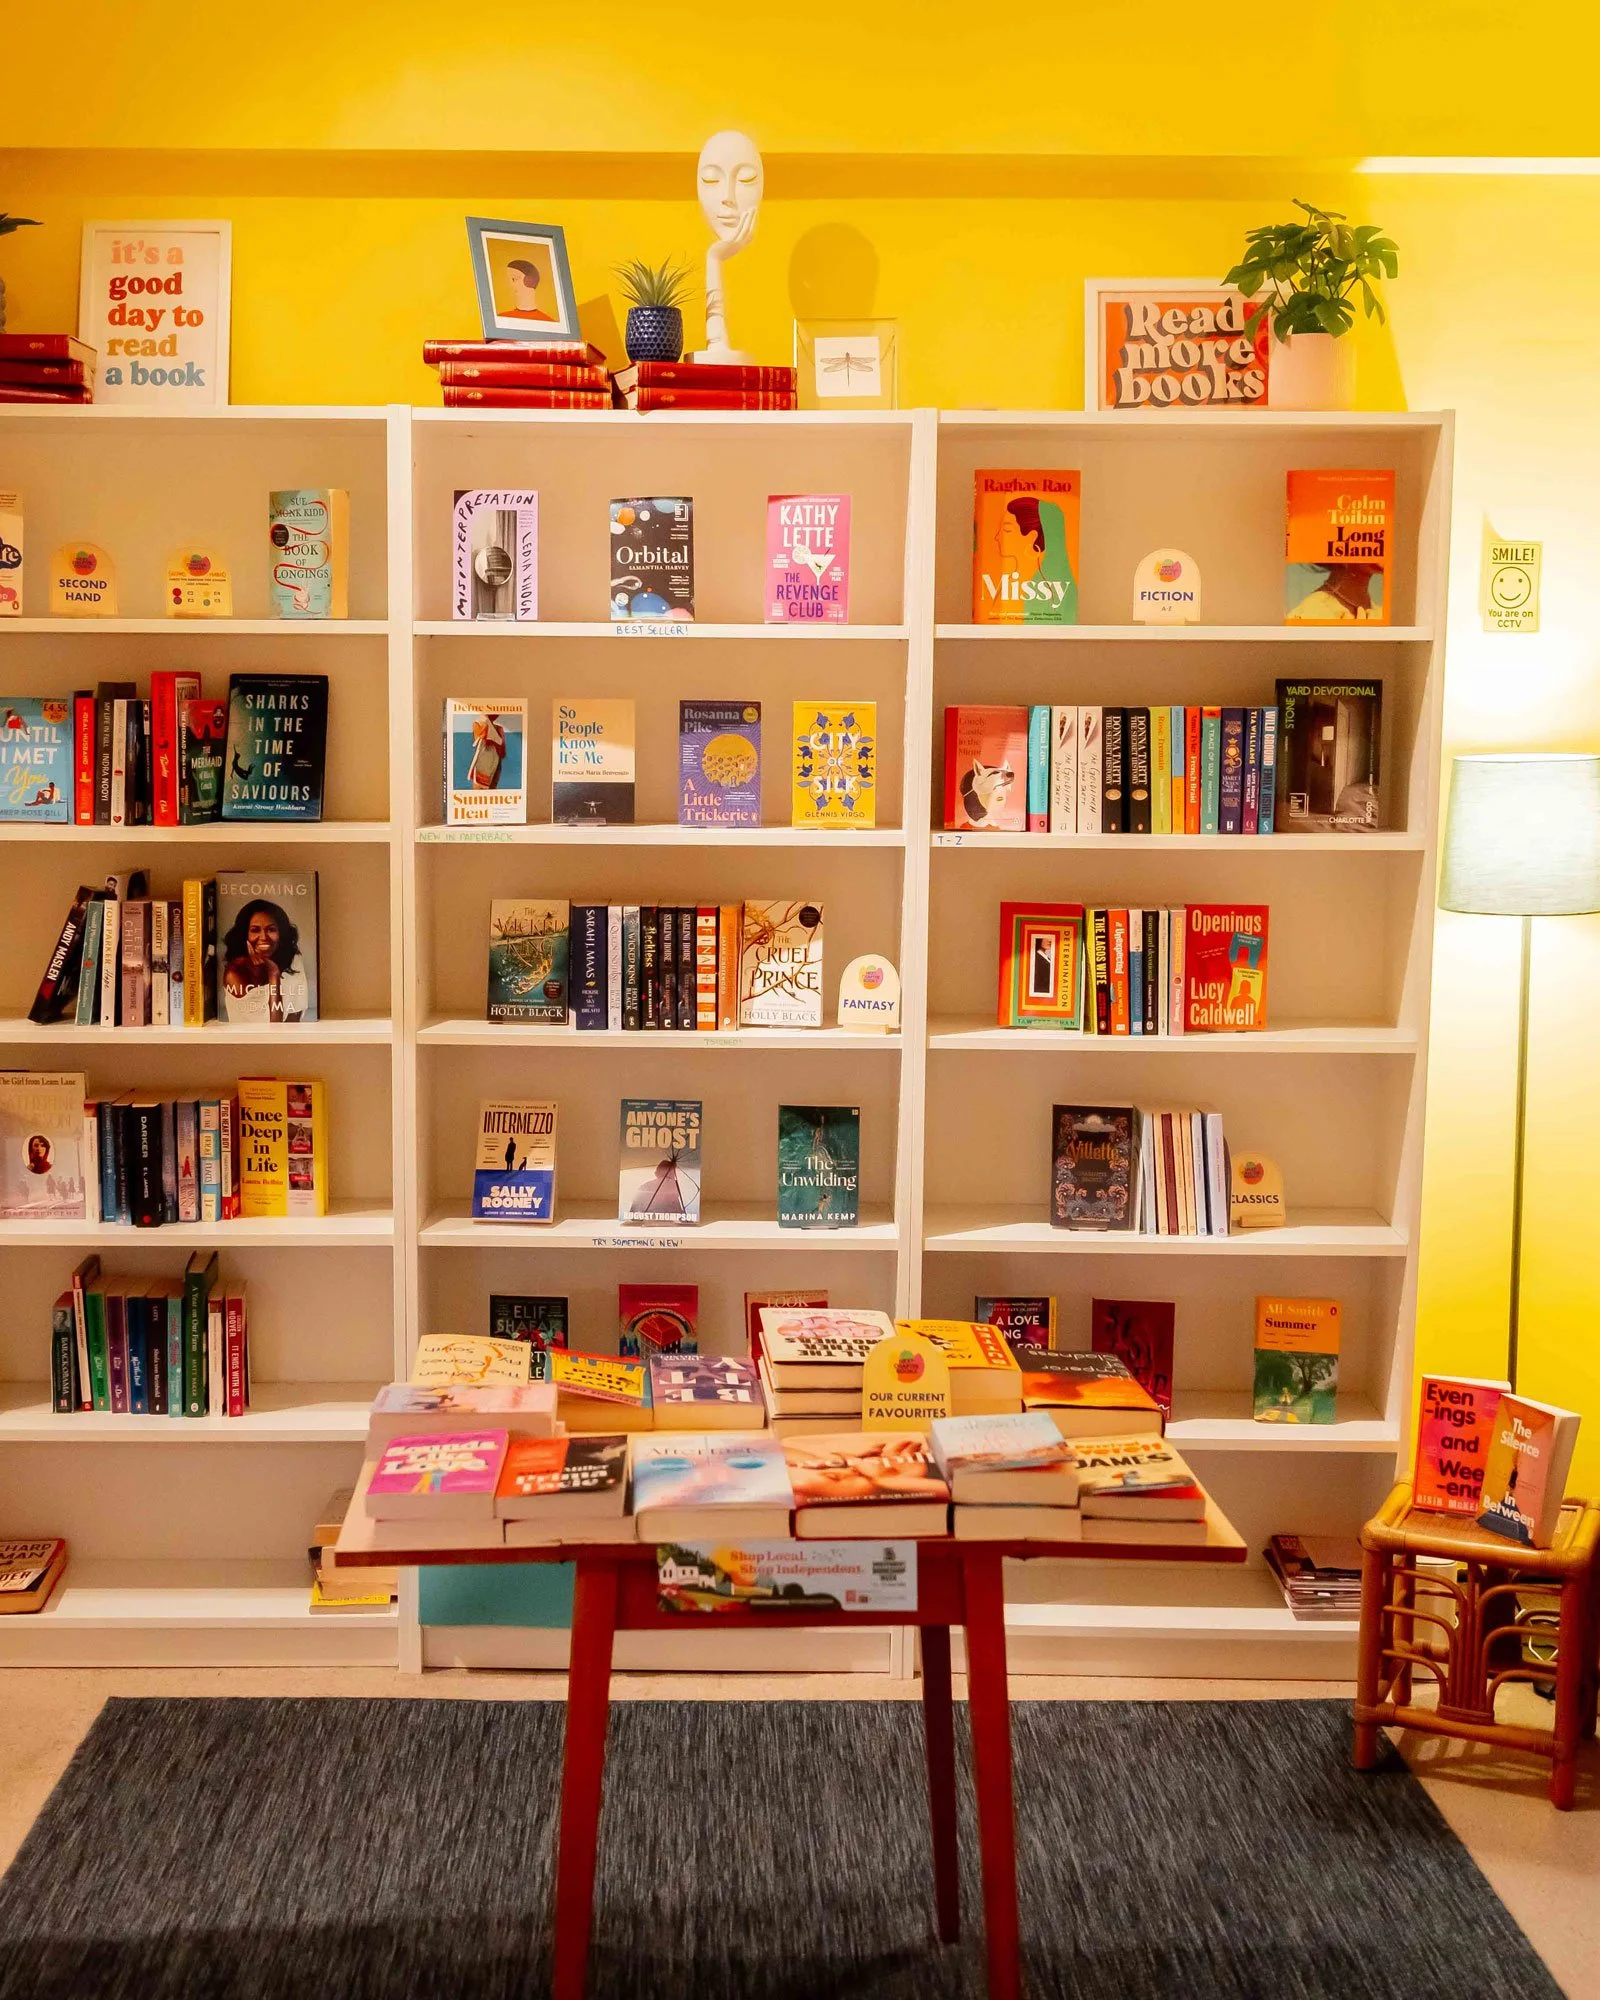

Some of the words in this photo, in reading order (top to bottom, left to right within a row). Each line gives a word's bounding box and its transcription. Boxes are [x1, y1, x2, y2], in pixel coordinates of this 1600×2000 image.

[111, 240, 160, 265] it's
[167, 246, 183, 265] a
[109, 272, 182, 300] good
[108, 303, 165, 331] day
[173, 306, 204, 327] to
[1125, 297, 1245, 345] Read
[106, 334, 178, 357] read
[1121, 339, 1255, 370] more
[105, 365, 122, 385] a
[130, 361, 205, 386] book
[1115, 363, 1266, 407] books
[984, 479, 1038, 493] Raghav
[1043, 479, 1072, 493] Rao
[1337, 494, 1386, 511] Colm
[304, 507, 325, 517] KIDD
[780, 505, 839, 525] KATHY
[783, 527, 835, 548] LETTE
[1337, 526, 1385, 544] Long
[284, 545, 319, 556] BOOK
[457, 493, 534, 616] MISINTERPRETATION
[521, 532, 532, 572] LEDIA
[616, 545, 689, 564] Orbital
[1327, 541, 1385, 557] Island
[1492, 547, 1535, 561] SMILE!
[275, 570, 329, 578] LONGINGS
[785, 572, 800, 582] THE
[59, 578, 107, 589] SECOND
[981, 571, 1071, 609] Missy
[65, 592, 101, 602] HAND
[776, 584, 839, 601] REVENGE
[1140, 591, 1194, 602] FICTION
[788, 602, 824, 618] CLUB
[1488, 609, 1503, 618] You
[616, 626, 644, 635] BEST
[648, 625, 688, 635] SELLER!
[1497, 619, 1522, 628] CCTV
[1286, 686, 1311, 696] YARD
[1313, 686, 1377, 696] DEVOTIONAL
[245, 694, 310, 711] SHARKS
[559, 705, 577, 720] So
[684, 708, 741, 720] Rosanna
[1249, 711, 1257, 724] TIA
[1285, 697, 1296, 729] STONE
[248, 717, 265, 733] IN
[274, 717, 304, 733] THE
[559, 720, 604, 738] People
[684, 721, 713, 734] Pike
[1112, 715, 1121, 750] DONNA
[1138, 715, 1146, 750] DONNA
[0, 726, 62, 744] UNTIL
[559, 735, 598, 750] Know
[809, 731, 862, 751] CITY
[255, 739, 294, 756] TIME
[1249, 725, 1257, 765] WILLIAMS
[13, 748, 58, 765] MET
[191, 756, 223, 770] MERMAID
[584, 751, 604, 765] Me
[1039, 745, 1048, 766] Love
[262, 762, 282, 778] OF
[1112, 752, 1121, 785] TARTT
[1138, 752, 1146, 785] TARTT
[1189, 756, 1197, 782] French
[231, 784, 311, 802] SAVIOURS
[683, 778, 696, 791] A
[812, 775, 859, 794] SILK
[683, 793, 722, 806] Little
[1189, 783, 1197, 804] Braid
[1328, 816, 1365, 824] CHARLOTTE
[420, 832, 440, 842] NEW
[459, 831, 513, 842] PAPERBACK
[220, 884, 307, 896] BECOMING
[586, 909, 596, 941] SARAH
[1094, 917, 1105, 933] THE
[1191, 909, 1262, 936] Openings
[60, 922, 77, 946] ANDY
[124, 920, 133, 959] CHILD
[134, 927, 142, 951] LEE
[188, 917, 197, 947] DENT
[104, 929, 112, 965] PARKER
[643, 926, 656, 968] Reckless
[755, 945, 811, 964] CRUEL
[1095, 936, 1106, 962] LAGOS
[47, 946, 68, 981] MASLEN
[586, 951, 596, 978] MAAS
[1061, 930, 1071, 1008] DETERMINATION
[751, 967, 819, 990] PRINCE
[1096, 963, 1107, 986] WIFE
[129, 975, 137, 1010] TRIPWIRE
[226, 984, 305, 997] MICHELLE
[1190, 976, 1225, 1004] Lucy
[490, 1007, 525, 1017] HOLLY
[528, 1008, 564, 1018] BLACK
[843, 999, 895, 1011] FANTASY
[744, 1011, 777, 1021] HOLLY
[782, 1012, 818, 1022] BLACK
[1189, 1002, 1256, 1026] Caldwell
[11, 1077, 24, 1086] Girl
[25, 1077, 40, 1086] from
[61, 1078, 76, 1086] Lane
[241, 1107, 283, 1122] Knee
[483, 1111, 554, 1135] INTERMEZZO
[626, 1111, 700, 1127] ANYONE'S
[222, 1118, 230, 1137] HEART
[241, 1123, 283, 1142] Deep
[625, 1127, 700, 1150] GHOST
[253, 1140, 270, 1155] in
[246, 1157, 278, 1173] Life
[804, 1155, 834, 1171] The
[782, 1172, 857, 1191] Unwilding
[490, 1185, 537, 1198] SALLY
[481, 1197, 543, 1209] ROONEY
[623, 1211, 653, 1221] AUGUST
[654, 1212, 697, 1221] THOMPSON
[781, 1213, 823, 1221] MARINA
[827, 1213, 856, 1221] KEMP
[592, 1238, 607, 1246] TRY
[612, 1239, 656, 1247] SOMETHING
[660, 1240, 683, 1248] NEW!
[513, 1304, 548, 1319] ELIF
[191, 1319, 199, 1332] Our
[228, 1310, 236, 1337] HOOVER
[995, 1315, 1005, 1325] A
[1008, 1315, 1040, 1326] LOVE
[1264, 1317, 1317, 1331] Summer
[191, 1334, 199, 1352] Farm
[231, 1352, 240, 1369] ENDS
[231, 1370, 240, 1388] WITH
[231, 1389, 240, 1397] US
[869, 1392, 893, 1401] OUR
[897, 1392, 945, 1401] CURRENT
[1427, 1383, 1474, 1407] Even
[868, 1407, 947, 1418] FAVOURITES
[1425, 1401, 1476, 1428] -ings
[1512, 1417, 1532, 1439] The
[1440, 1436, 1479, 1453] and
[1500, 1430, 1540, 1458] Silence
[1075, 1452, 1173, 1469] JAMES
[1504, 1491, 1516, 1507] In
[1483, 1495, 1535, 1528] Between
[730, 1551, 765, 1562] Shop
[739, 1564, 774, 1576] Shop
